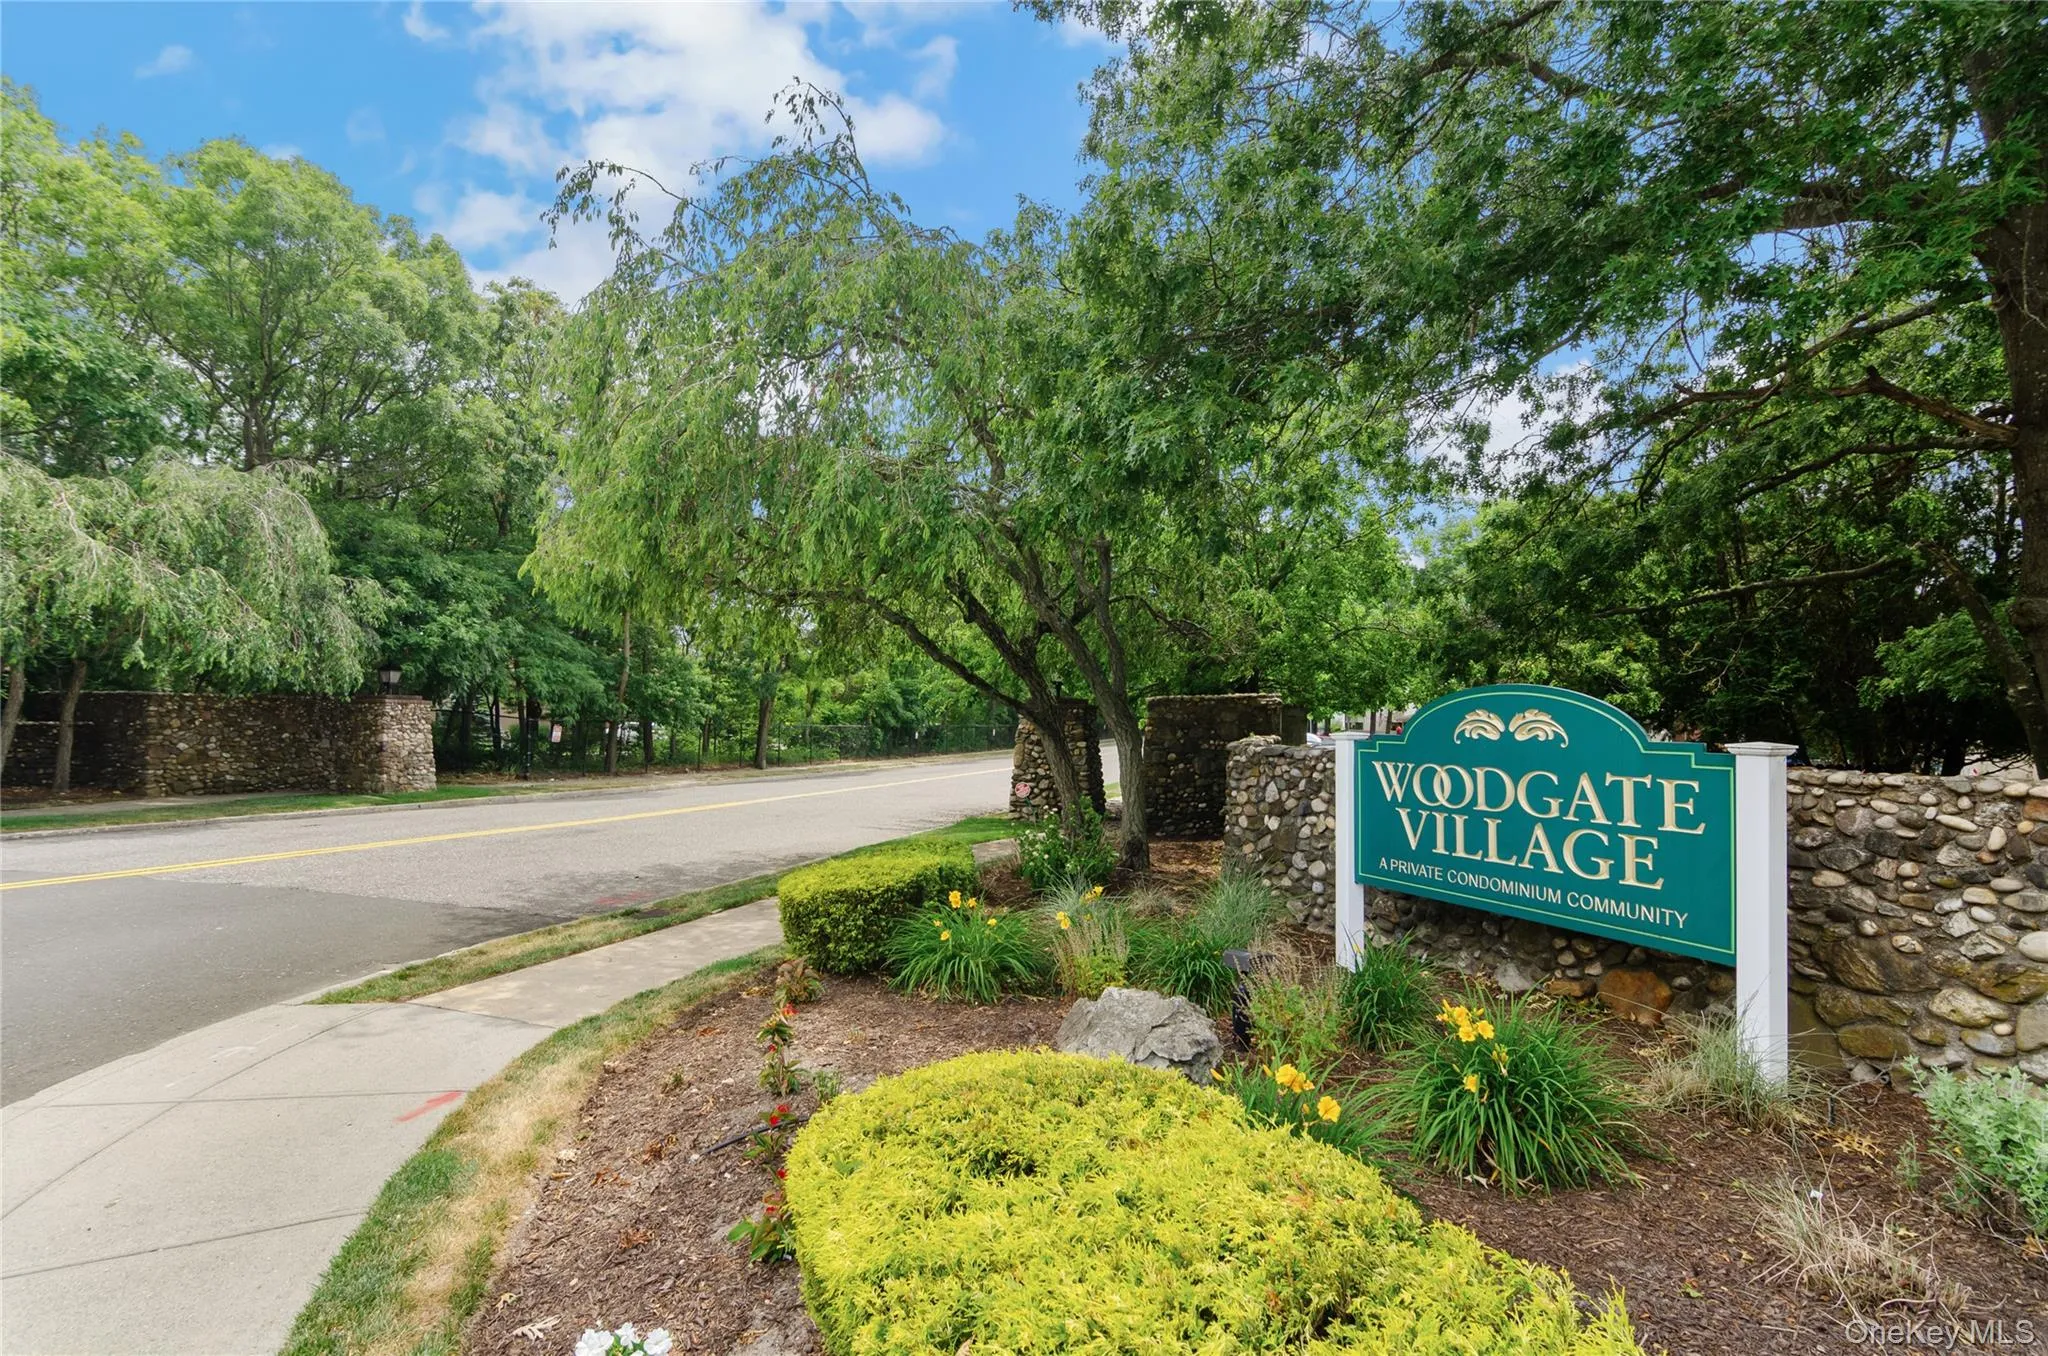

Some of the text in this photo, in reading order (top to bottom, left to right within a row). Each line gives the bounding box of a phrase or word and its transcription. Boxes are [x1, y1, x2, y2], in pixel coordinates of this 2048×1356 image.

[1371, 760, 1706, 835] WOODGATE
[1395, 807, 1664, 890] VILLAGE
[1379, 857, 1688, 929] A PRIVATE CONDOMINIUM COMMUNITY
